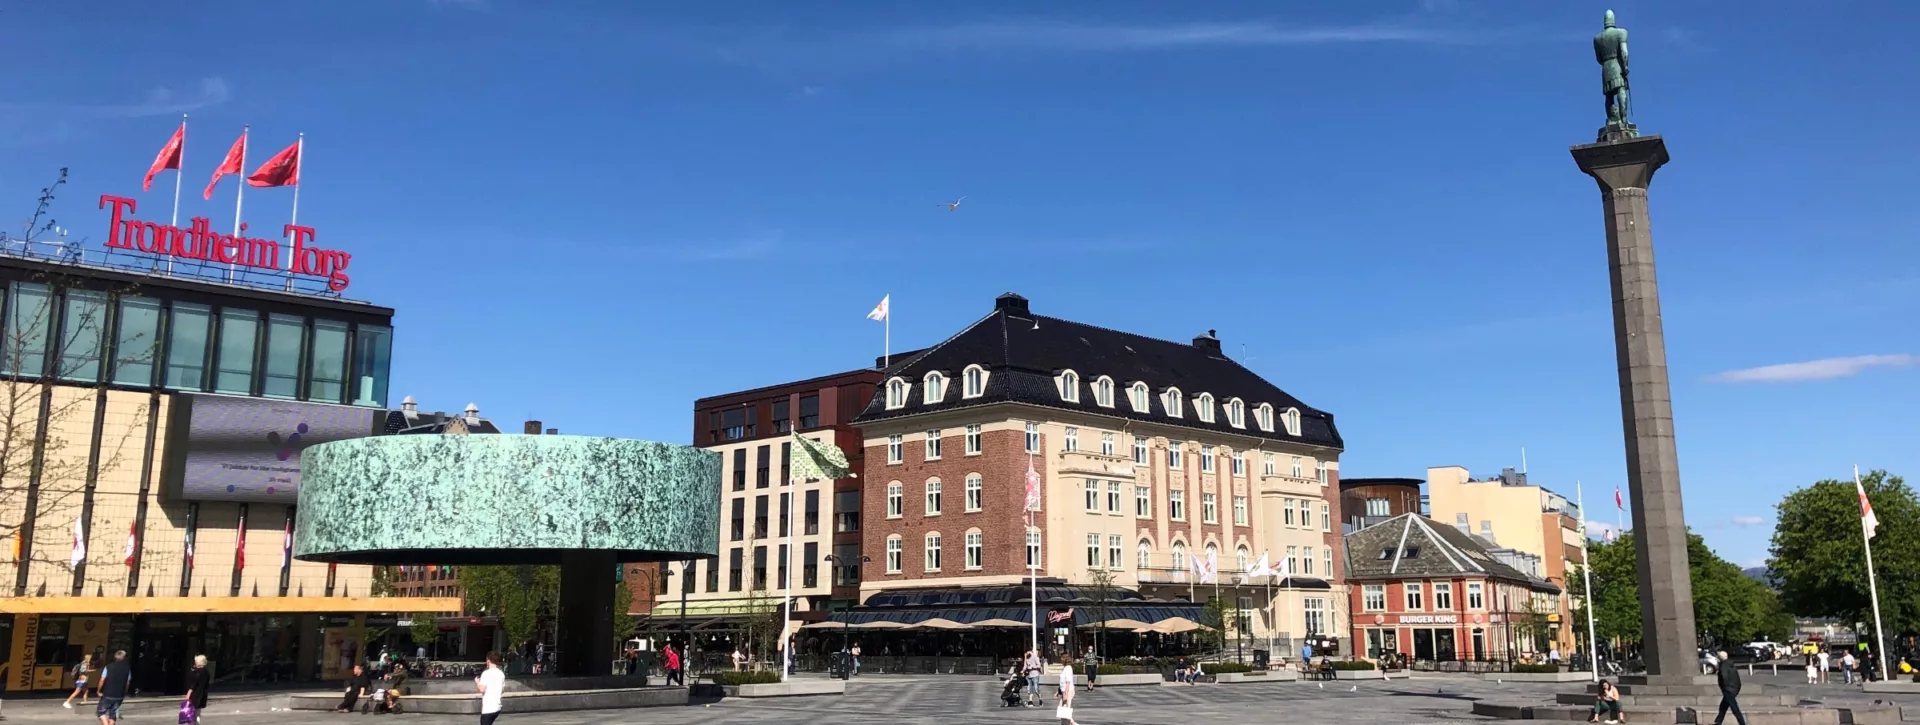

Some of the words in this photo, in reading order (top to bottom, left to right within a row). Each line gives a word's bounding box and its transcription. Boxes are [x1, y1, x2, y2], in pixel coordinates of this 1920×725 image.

[99, 194, 279, 270] Trondheim
[283, 224, 352, 292] Torg
[20, 617, 38, 688] WALK-THRU
[1399, 615, 1434, 624] BURGER
[1434, 614, 1457, 624] KING
